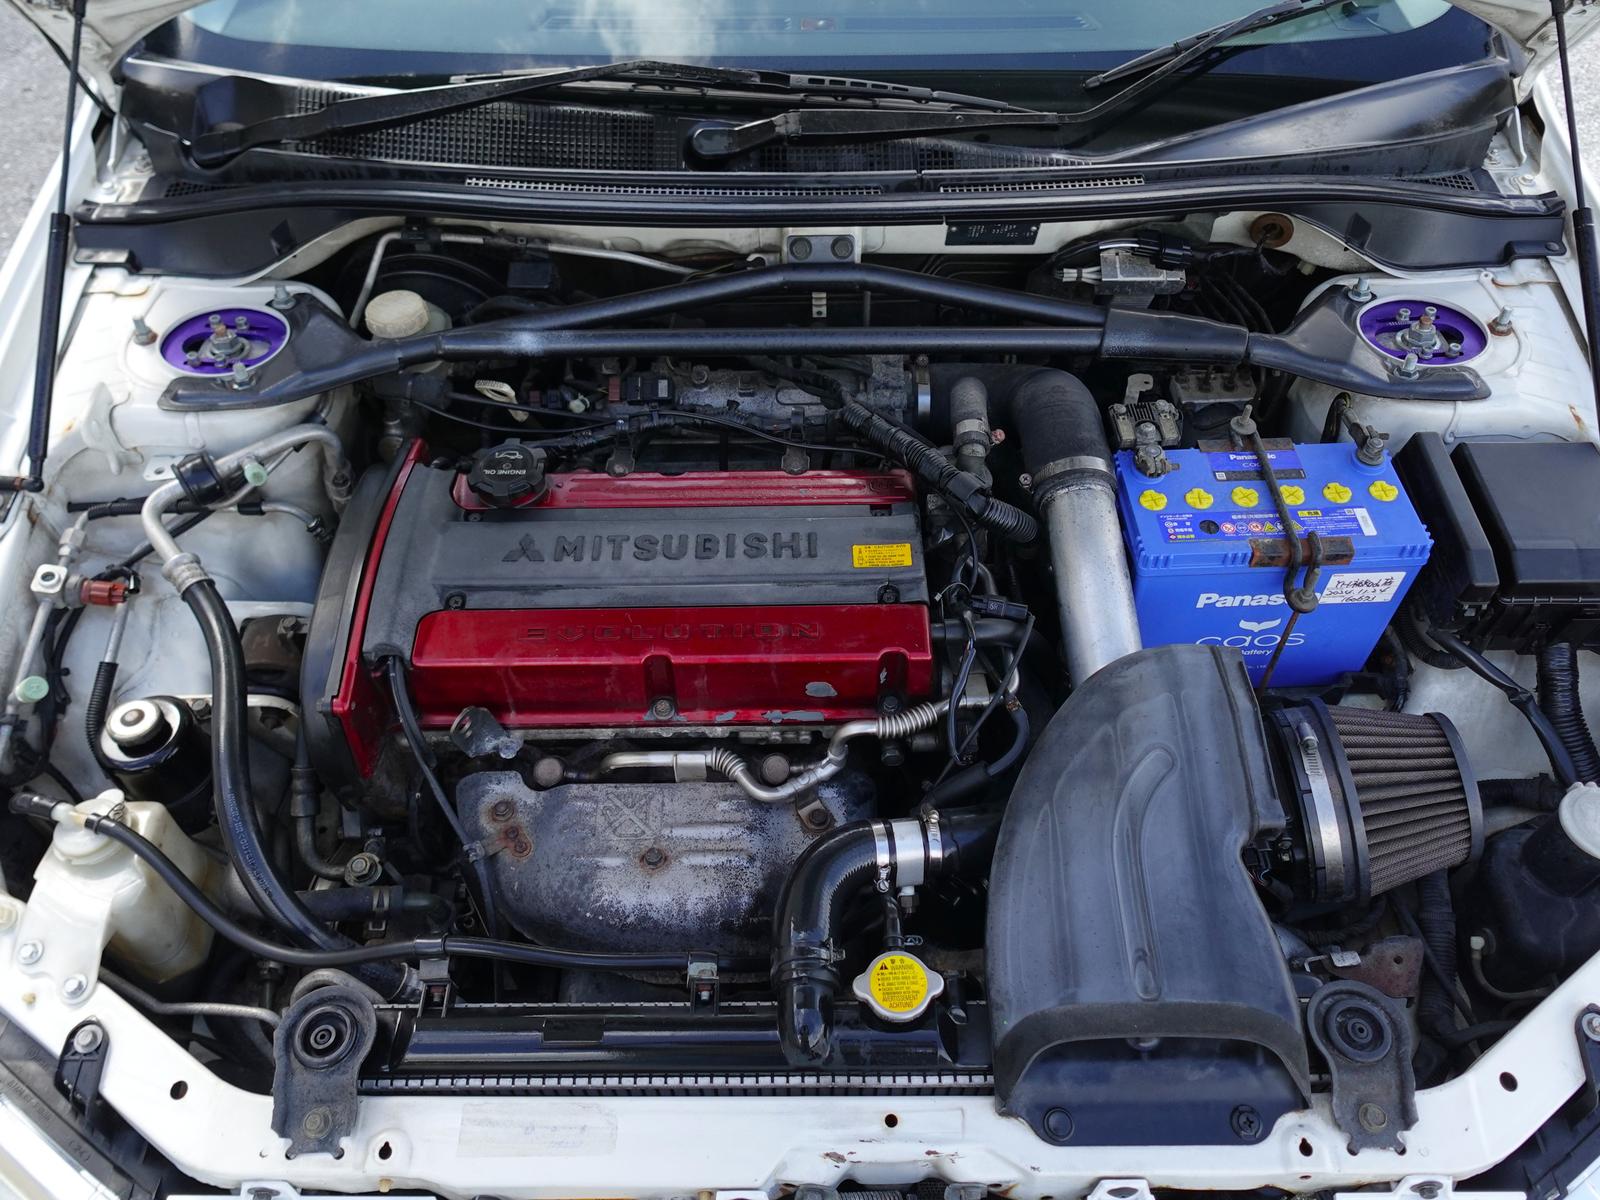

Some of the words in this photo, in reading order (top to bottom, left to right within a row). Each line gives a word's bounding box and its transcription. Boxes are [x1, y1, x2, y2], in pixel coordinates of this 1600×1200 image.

[1229, 453, 1276, 461] Panasic
[553, 532, 818, 562] MITSUBISHI
[518, 622, 821, 641] EVOLUTION
